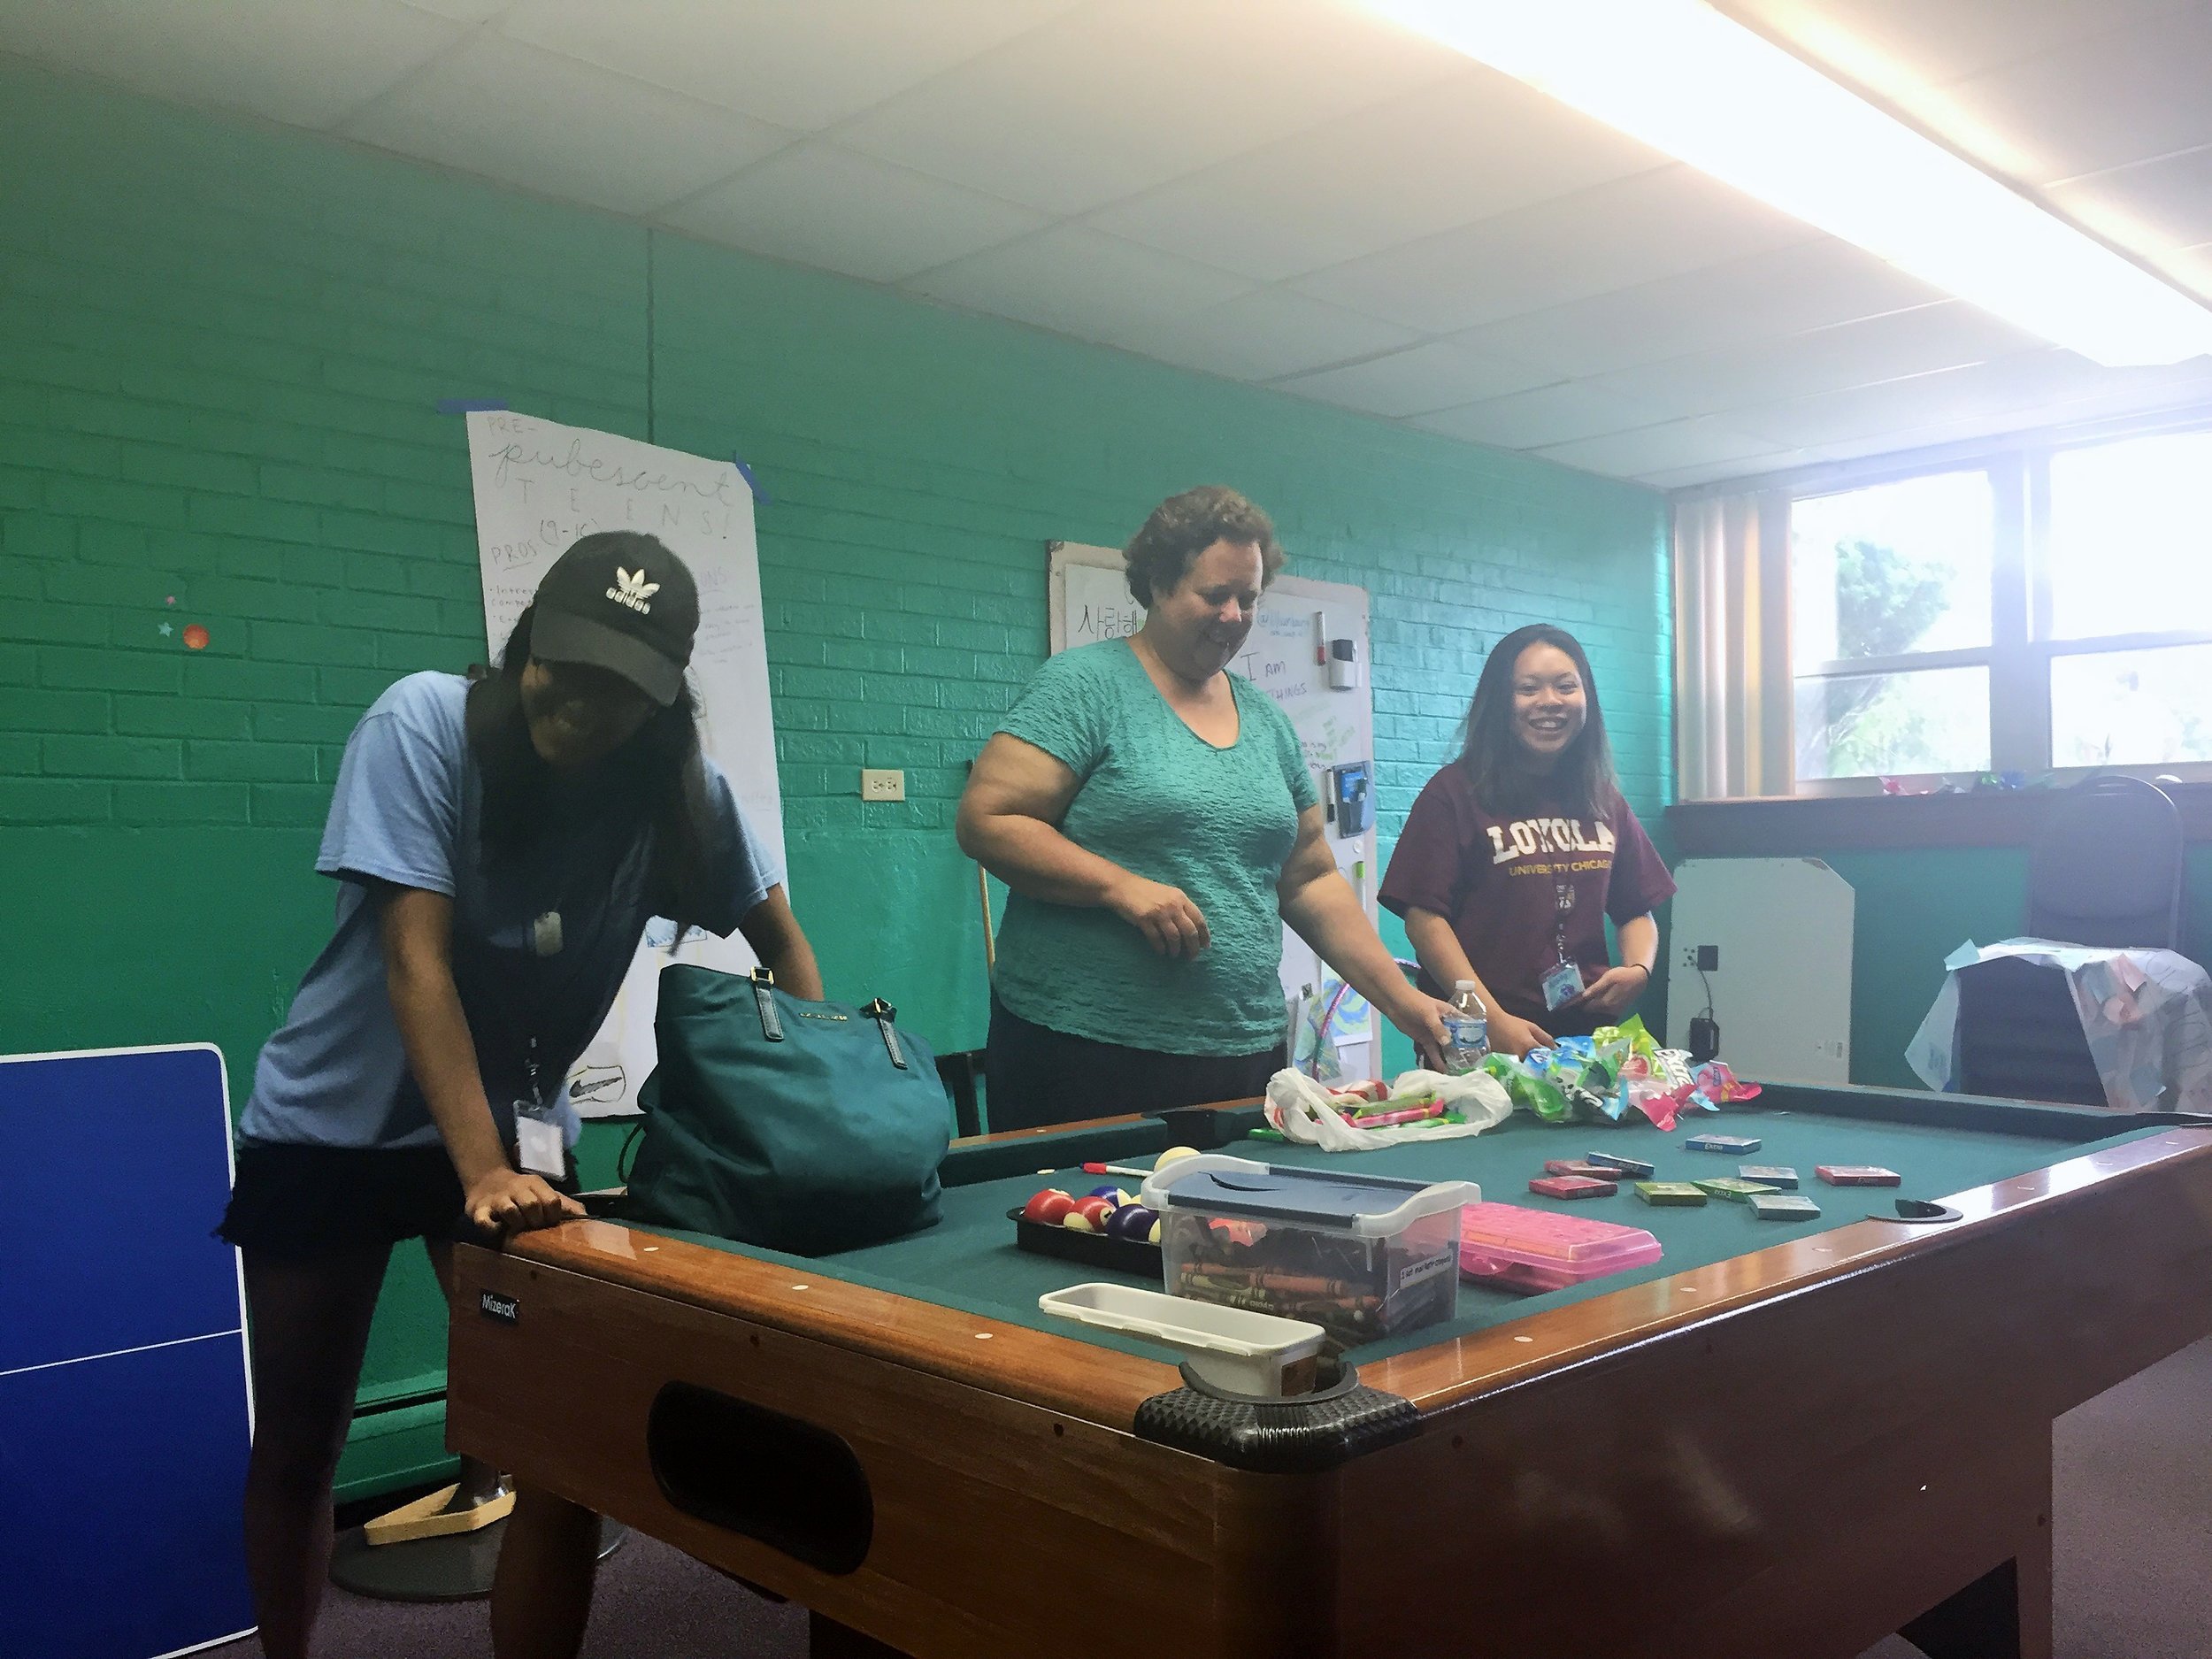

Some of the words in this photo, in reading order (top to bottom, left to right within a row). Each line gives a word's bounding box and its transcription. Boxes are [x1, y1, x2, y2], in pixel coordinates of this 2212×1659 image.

[605, 587, 651, 615] adidas
[1078, 604, 1138, 641] 사랑해
[1240, 652, 1259, 681] I
[1265, 661, 1286, 678] AM
[1486, 818, 1616, 865] LOYOLA
